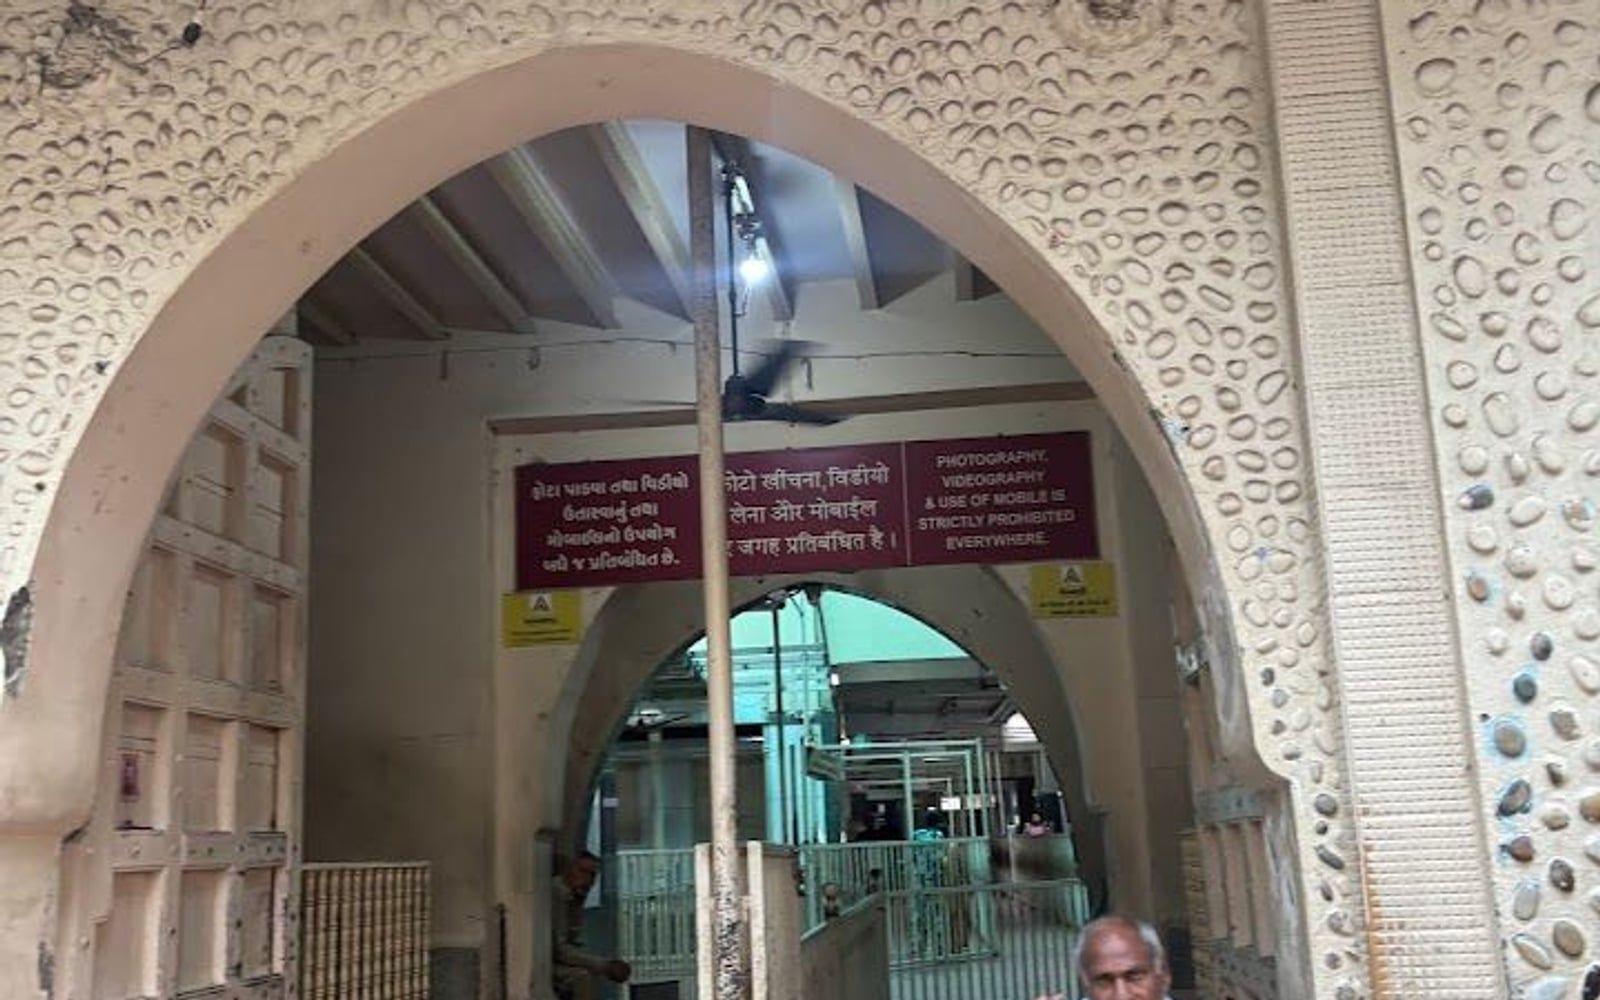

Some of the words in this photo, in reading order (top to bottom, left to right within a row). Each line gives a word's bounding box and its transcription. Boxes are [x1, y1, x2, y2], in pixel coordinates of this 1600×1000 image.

[609, 480, 638, 493] તથા
[942, 471, 1045, 488] VIDEOGRAPHY
[925, 498, 936, 510] &
[938, 494, 967, 508] USE
[971, 492, 990, 507] OF
[993, 489, 1048, 505] MOBILE
[1051, 488, 1066, 502] IS
[629, 502, 658, 517] તથા
[729, 501, 766, 524] लेना
[769, 499, 804, 521] और
[807, 496, 878, 521] मोबाईल
[918, 514, 985, 531] STRICTLY
[988, 509, 1075, 526] PROHIBITED
[624, 523, 676, 541] ઉપયોગ
[736, 538, 781, 557] जगह
[785, 531, 865, 554] प्रतिबंधित
[571, 557, 586, 571] જ
